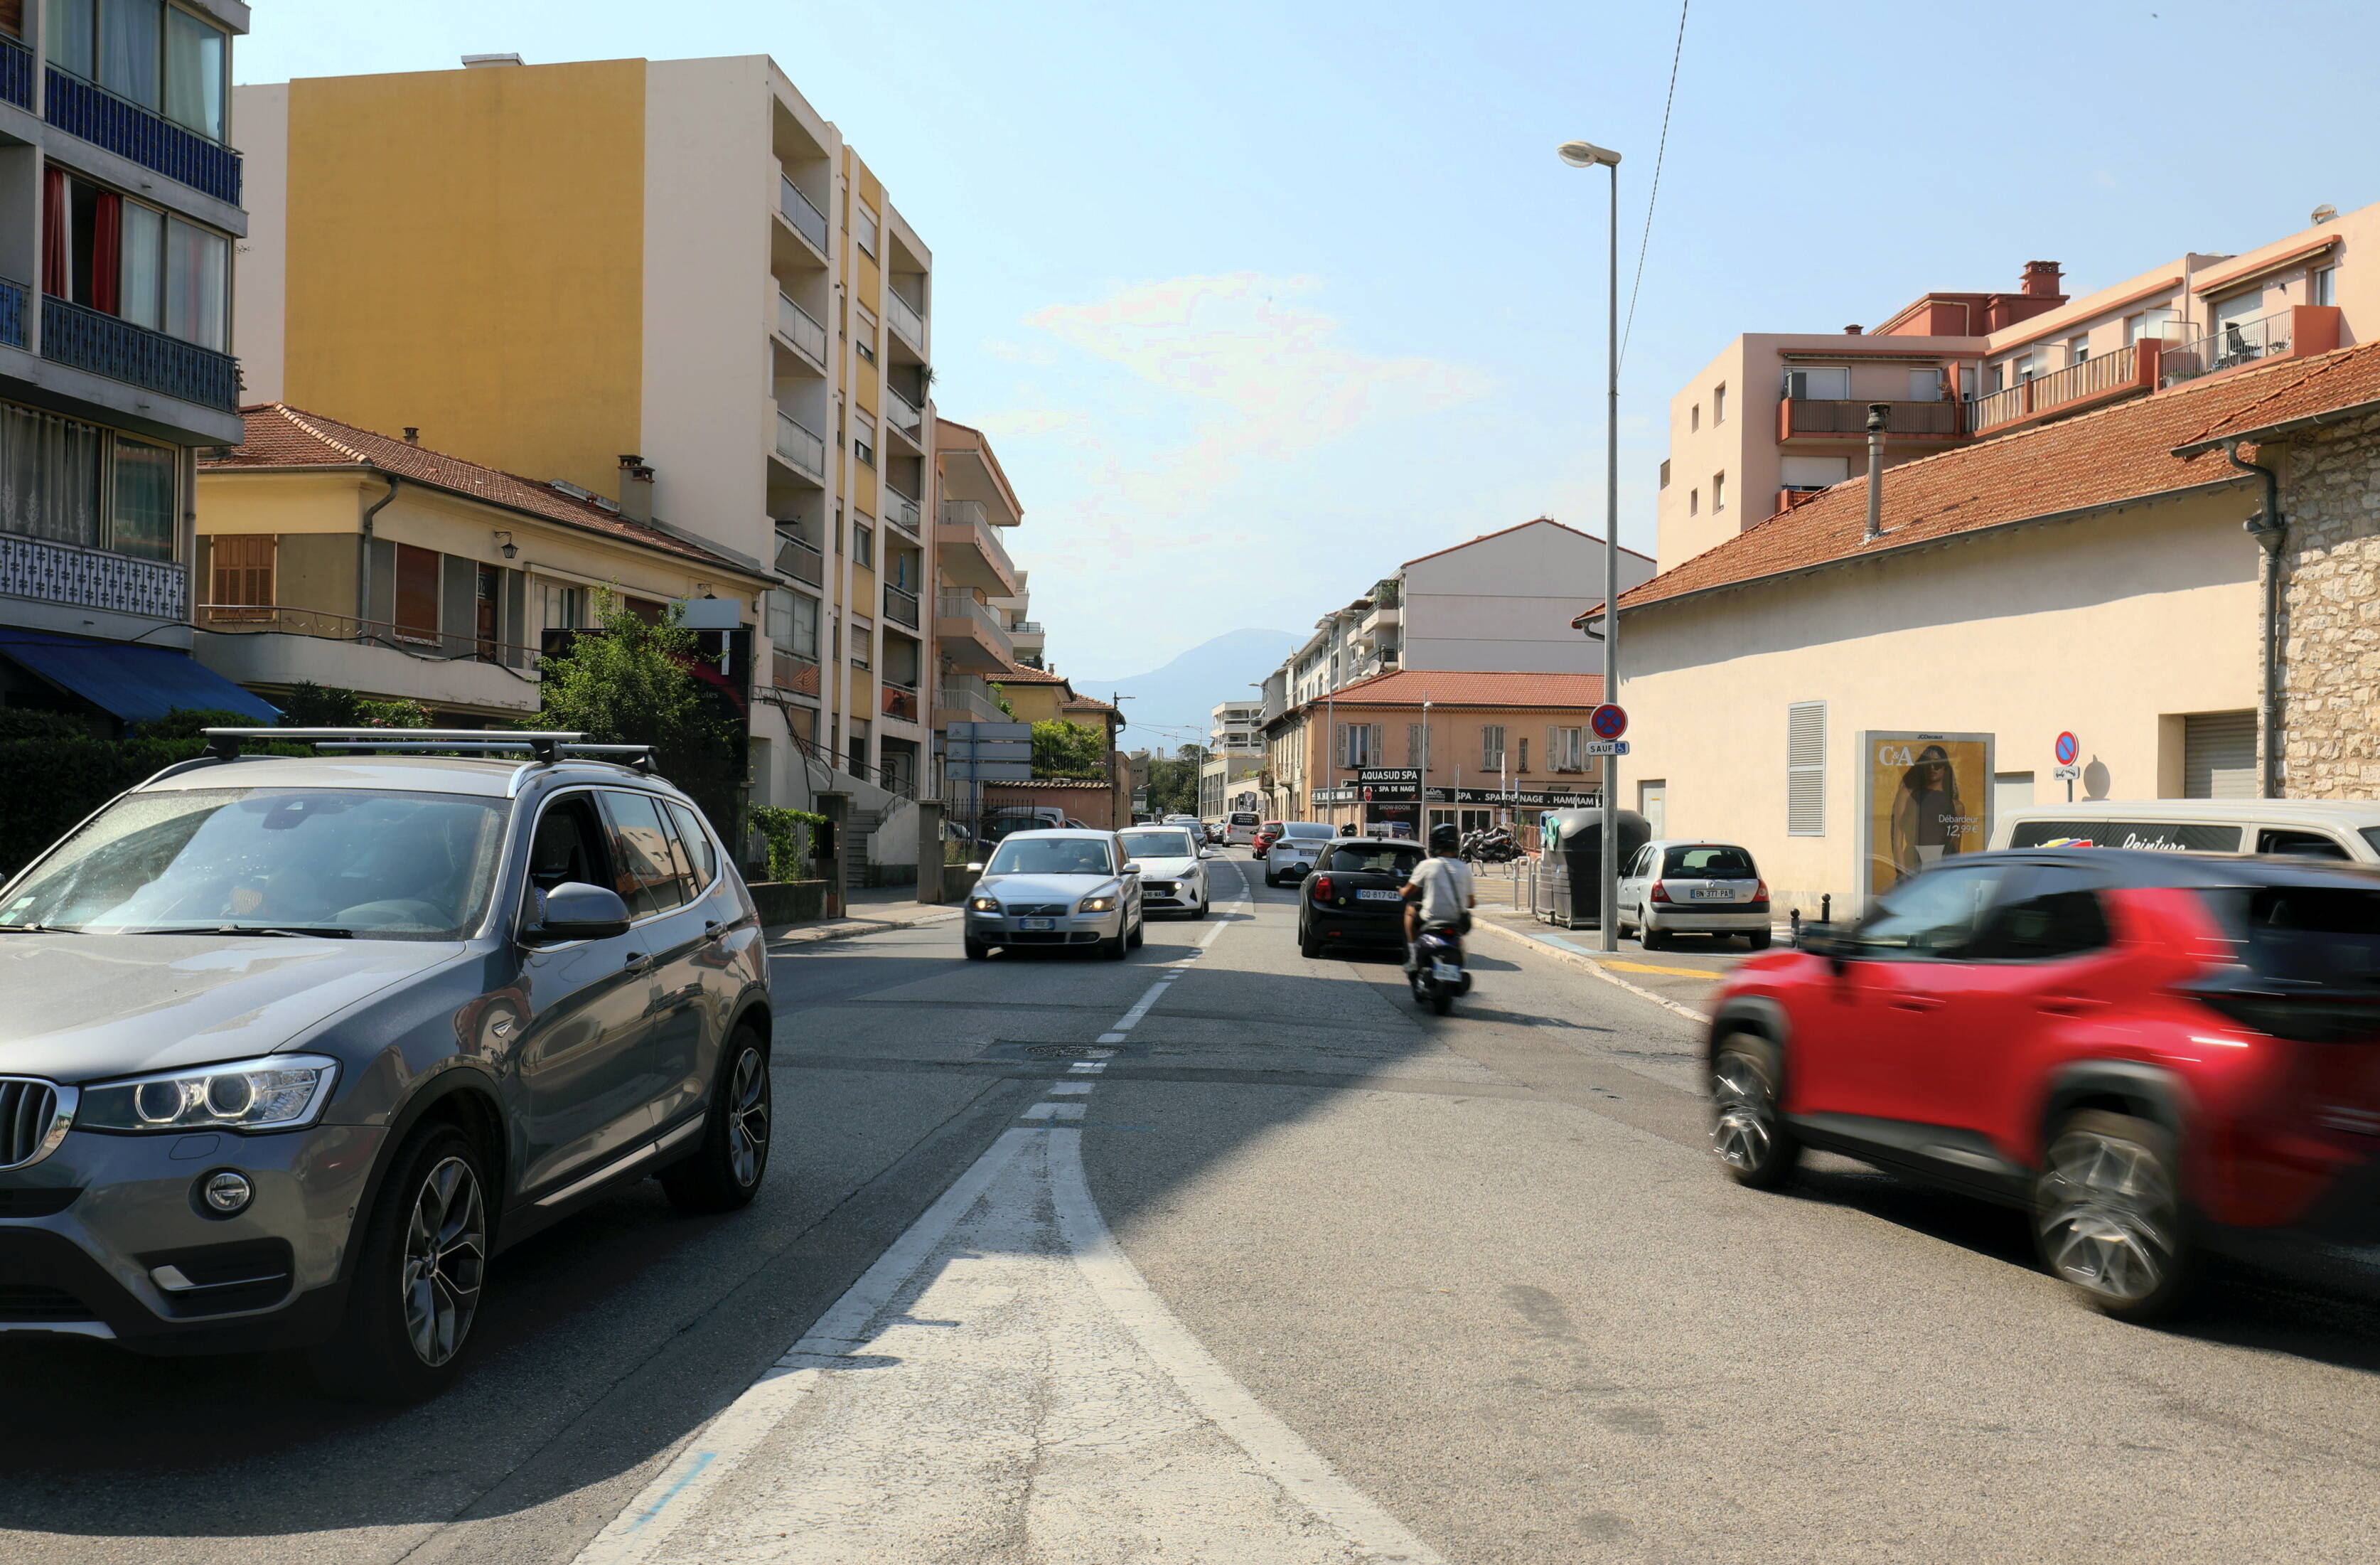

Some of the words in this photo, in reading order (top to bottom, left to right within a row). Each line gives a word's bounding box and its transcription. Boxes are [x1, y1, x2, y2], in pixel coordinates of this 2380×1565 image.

[1590, 744, 1612, 753] SAUF
[1879, 744, 1915, 767] C&A
[1361, 770, 1400, 780] AQUASUD
[1401, 770, 1417, 780] SPA
[1485, 794, 1501, 802] SPA
[1520, 795, 1544, 803] NAGE
[1553, 796, 1594, 805] HAMMAM
[1939, 814, 1978, 823] Débardeur
